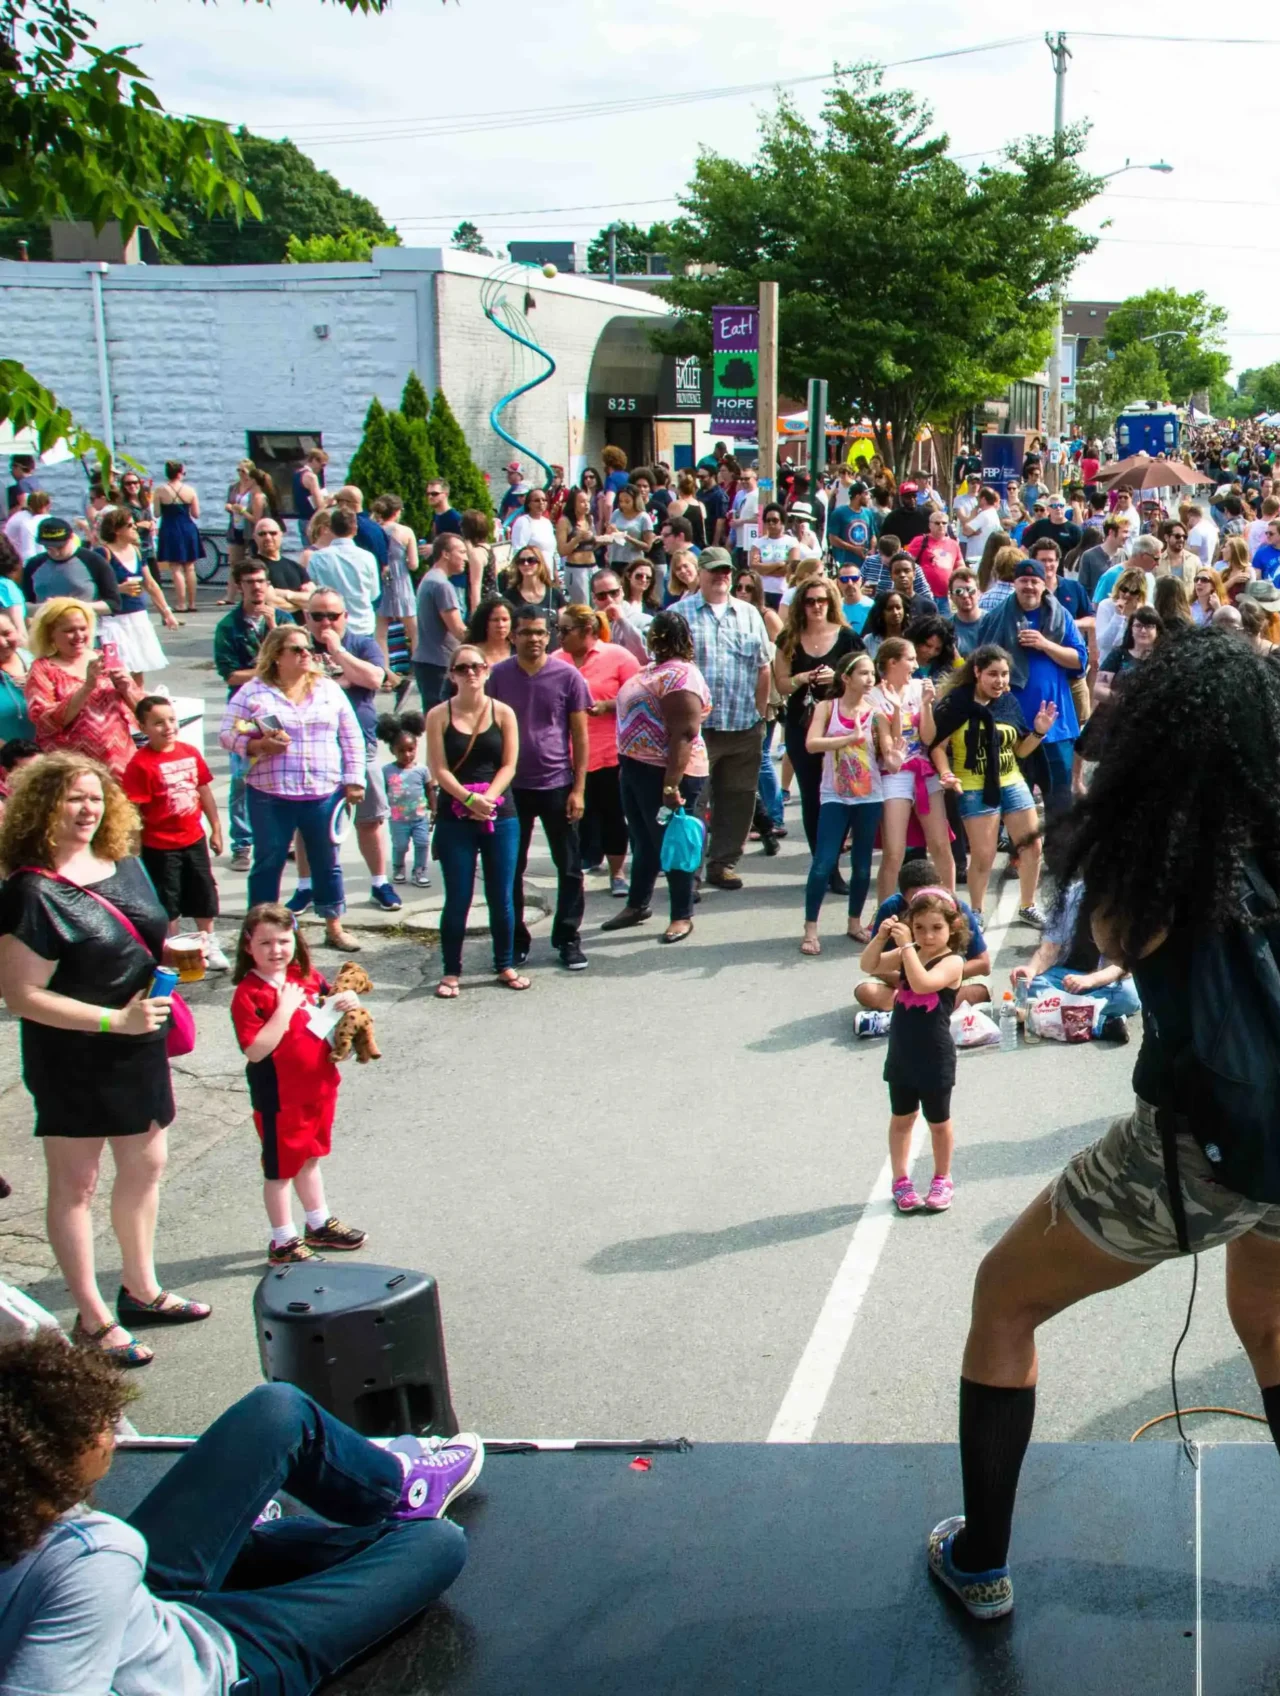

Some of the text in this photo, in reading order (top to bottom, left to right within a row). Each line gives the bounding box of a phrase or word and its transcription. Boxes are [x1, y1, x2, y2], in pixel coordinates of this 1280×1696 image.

[720, 314, 753, 339] Eat!
[676, 366, 702, 389] BALLET
[608, 398, 636, 411] 825
[716, 399, 754, 409] HOPE
